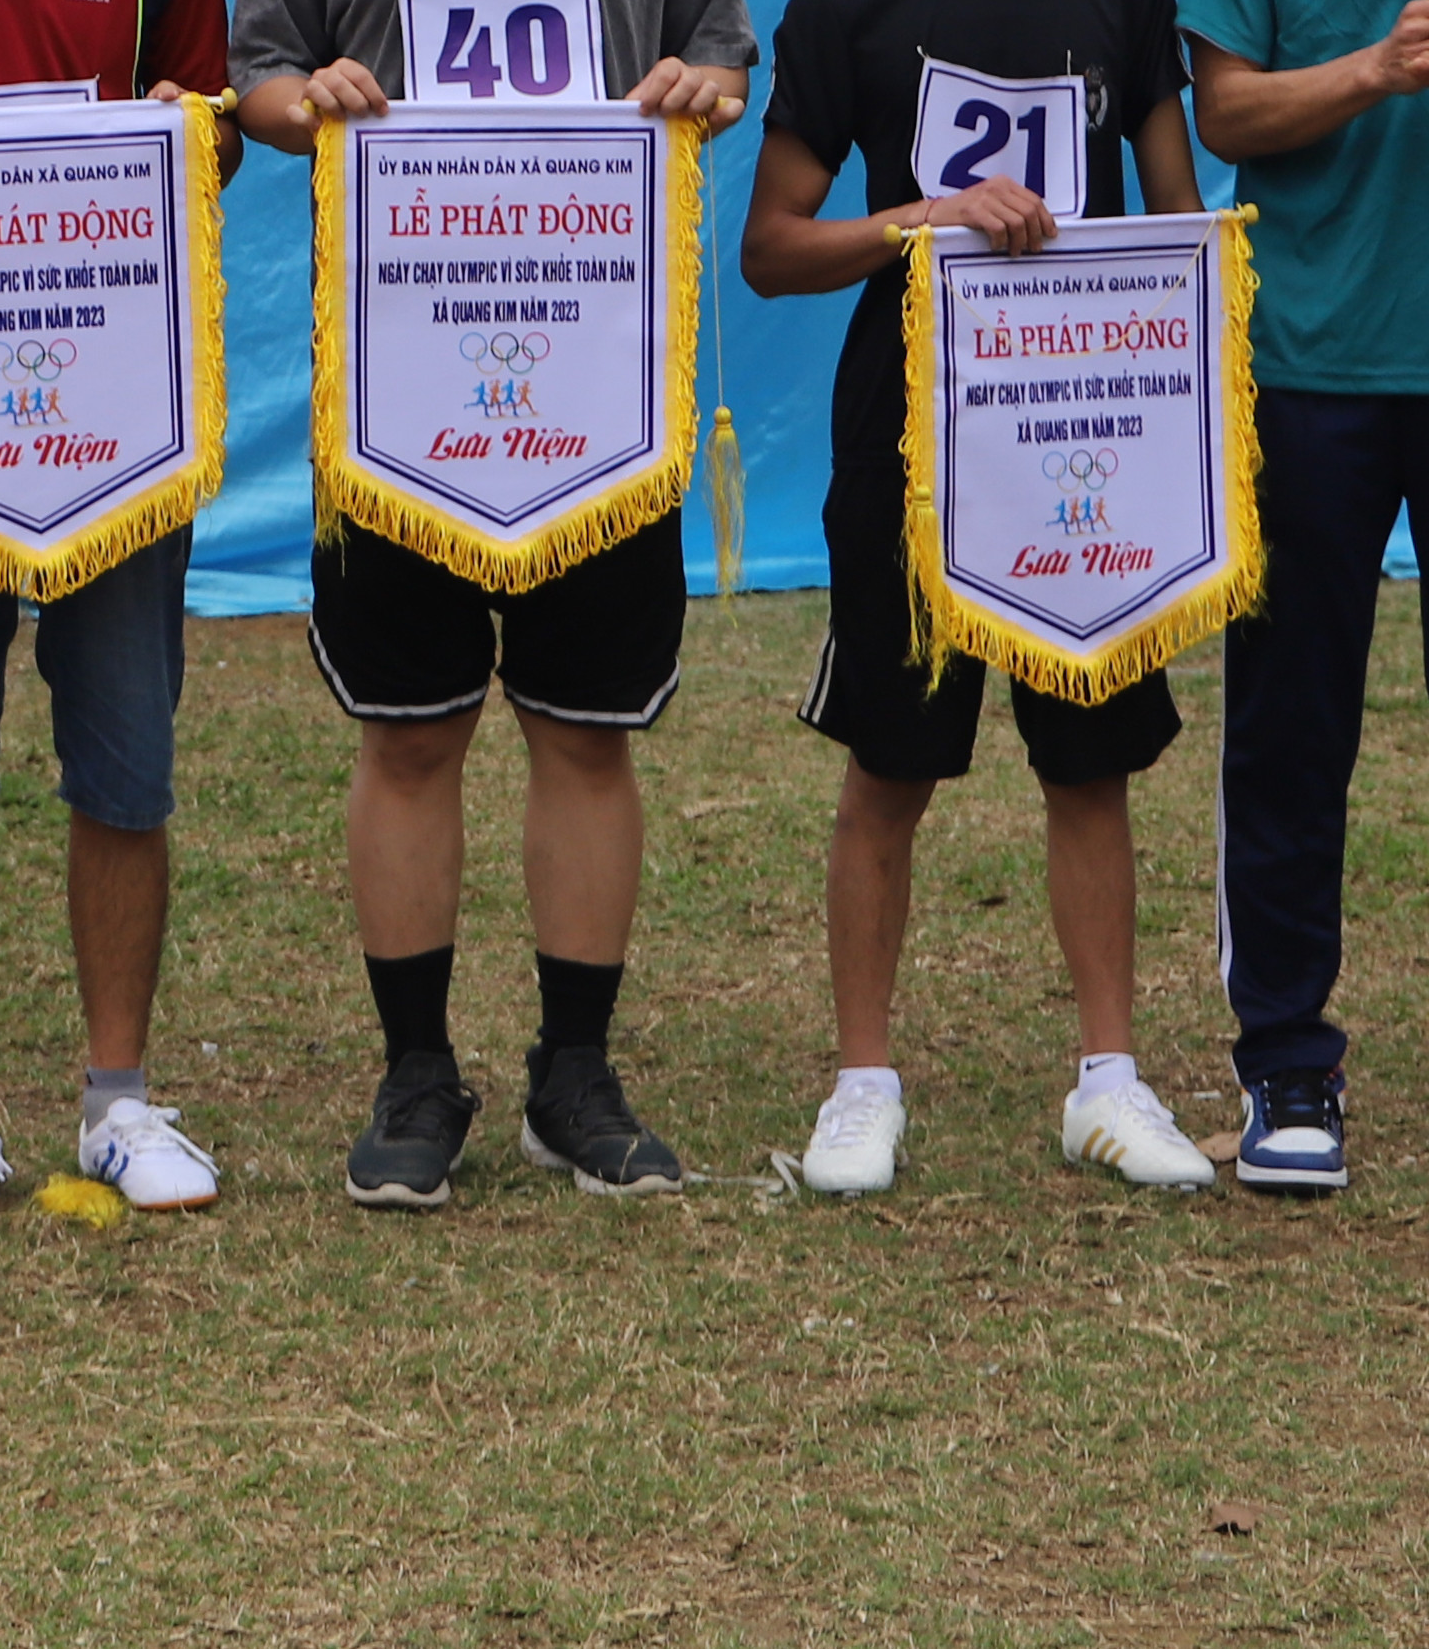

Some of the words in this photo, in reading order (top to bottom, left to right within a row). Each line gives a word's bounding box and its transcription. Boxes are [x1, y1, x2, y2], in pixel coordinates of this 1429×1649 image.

[437, 3, 570, 97] 40
[403, 161, 432, 175] BAN
[438, 157, 479, 175] NHÂN
[485, 156, 515, 174] DÂN
[522, 157, 540, 174] XÃ
[546, 160, 600, 173] QUANG
[606, 159, 632, 173] KIM
[941, 100, 1046, 198] 21
[2, 166, 33, 185] DÂN
[39, 165, 59, 182] XÃ
[64, 165, 118, 181] QUANG
[124, 163, 150, 178] KIM
[58, 200, 154, 248] ĐỘNG
[390, 188, 429, 236] LỄ
[441, 195, 527, 235] PHÁT
[539, 194, 633, 241] ĐỘNG
[23, 266, 34, 291] VÌ
[38, 267, 61, 290] SỨC
[65, 260, 96, 289] KHỎE
[99, 261, 130, 287] TOÀN
[134, 259, 158, 285] DÂN
[379, 259, 409, 284] NGÀY
[413, 262, 443, 288] CHẠY
[448, 261, 497, 283] OLYMPIC
[501, 257, 511, 282] VÌ
[516, 260, 538, 282] SỨC
[543, 254, 572, 282] KHỎE
[576, 256, 606, 282] TOÀN
[611, 256, 634, 282] DÂN
[19, 309, 42, 330] KIM
[45, 304, 72, 329] NĂM
[76, 305, 105, 327] 2023
[433, 297, 448, 322] XÃ
[452, 301, 490, 325] QUANG
[495, 301, 516, 322] KIM
[521, 297, 547, 321] NĂM
[552, 300, 579, 322] 2023
[974, 311, 1011, 358] LỄ
[1020, 314, 1093, 356] PHÁT
[1103, 310, 1188, 359] ĐỘNG
[34, 433, 117, 470] Niệm
[424, 428, 491, 461] Lưu
[503, 428, 586, 464] Niệm
